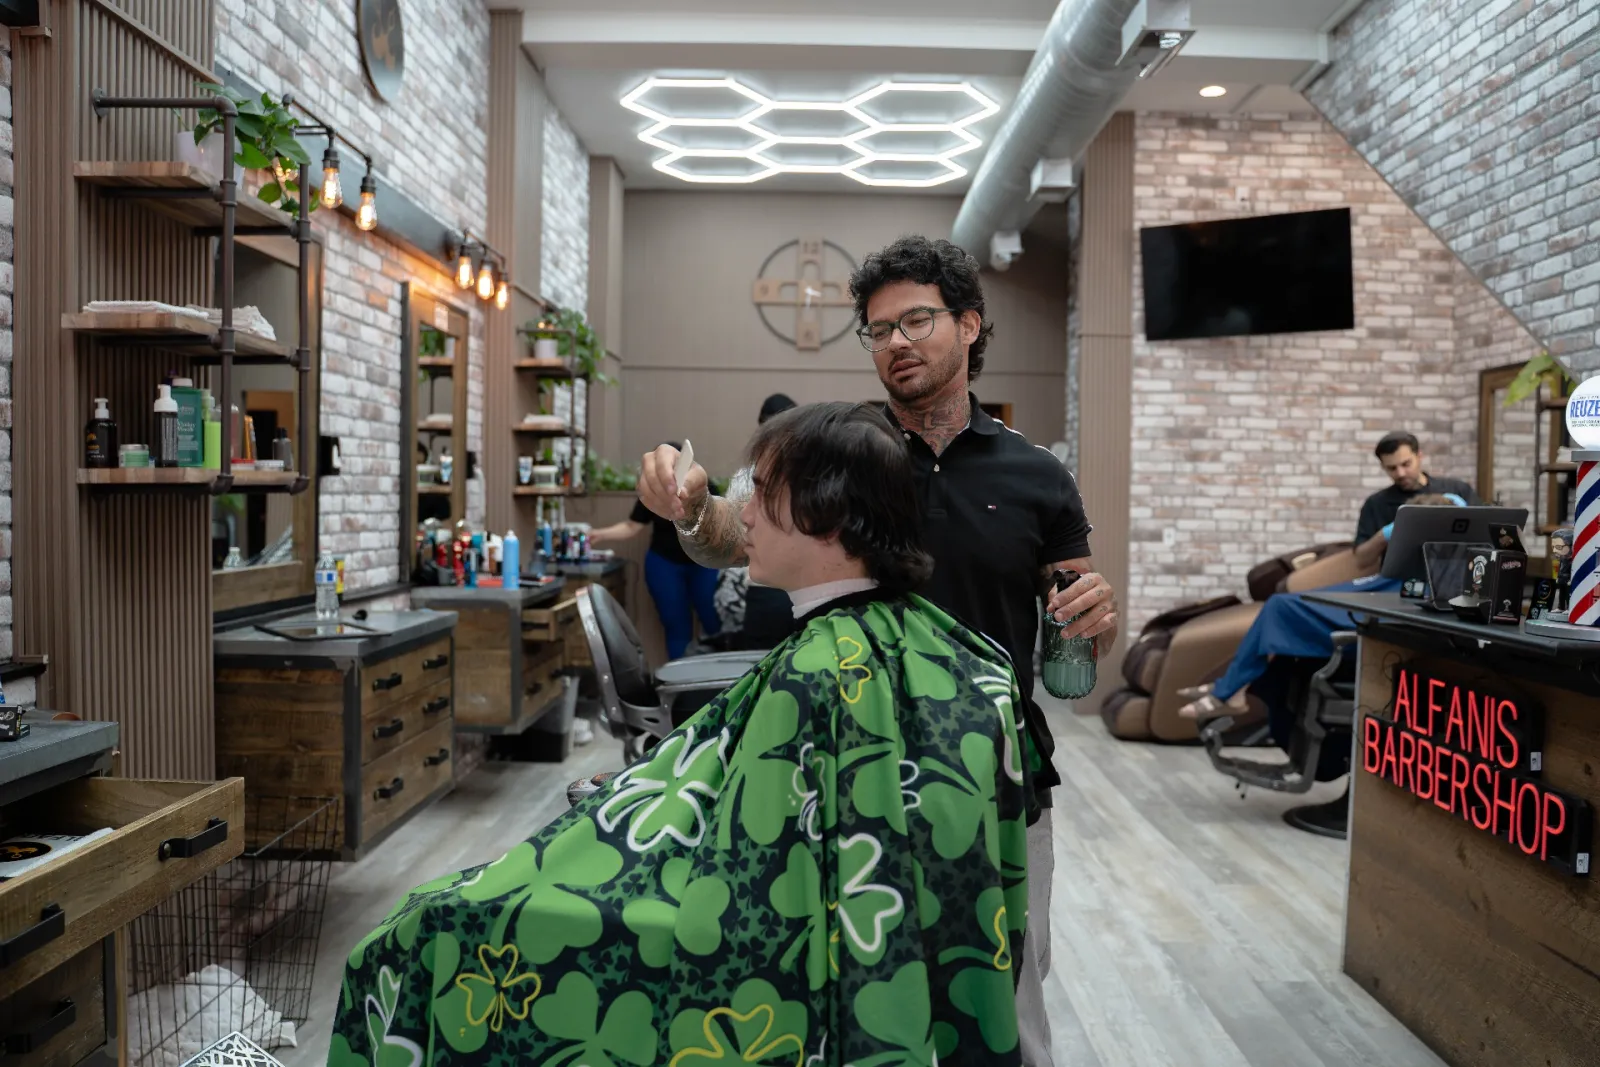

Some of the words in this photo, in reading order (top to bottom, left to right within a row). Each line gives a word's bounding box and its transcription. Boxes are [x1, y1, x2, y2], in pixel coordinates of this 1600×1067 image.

[1570, 400, 1600, 418] REUZE
[1393, 669, 1519, 769] ALFANIS
[1364, 717, 1566, 861] BARBERSHOP
